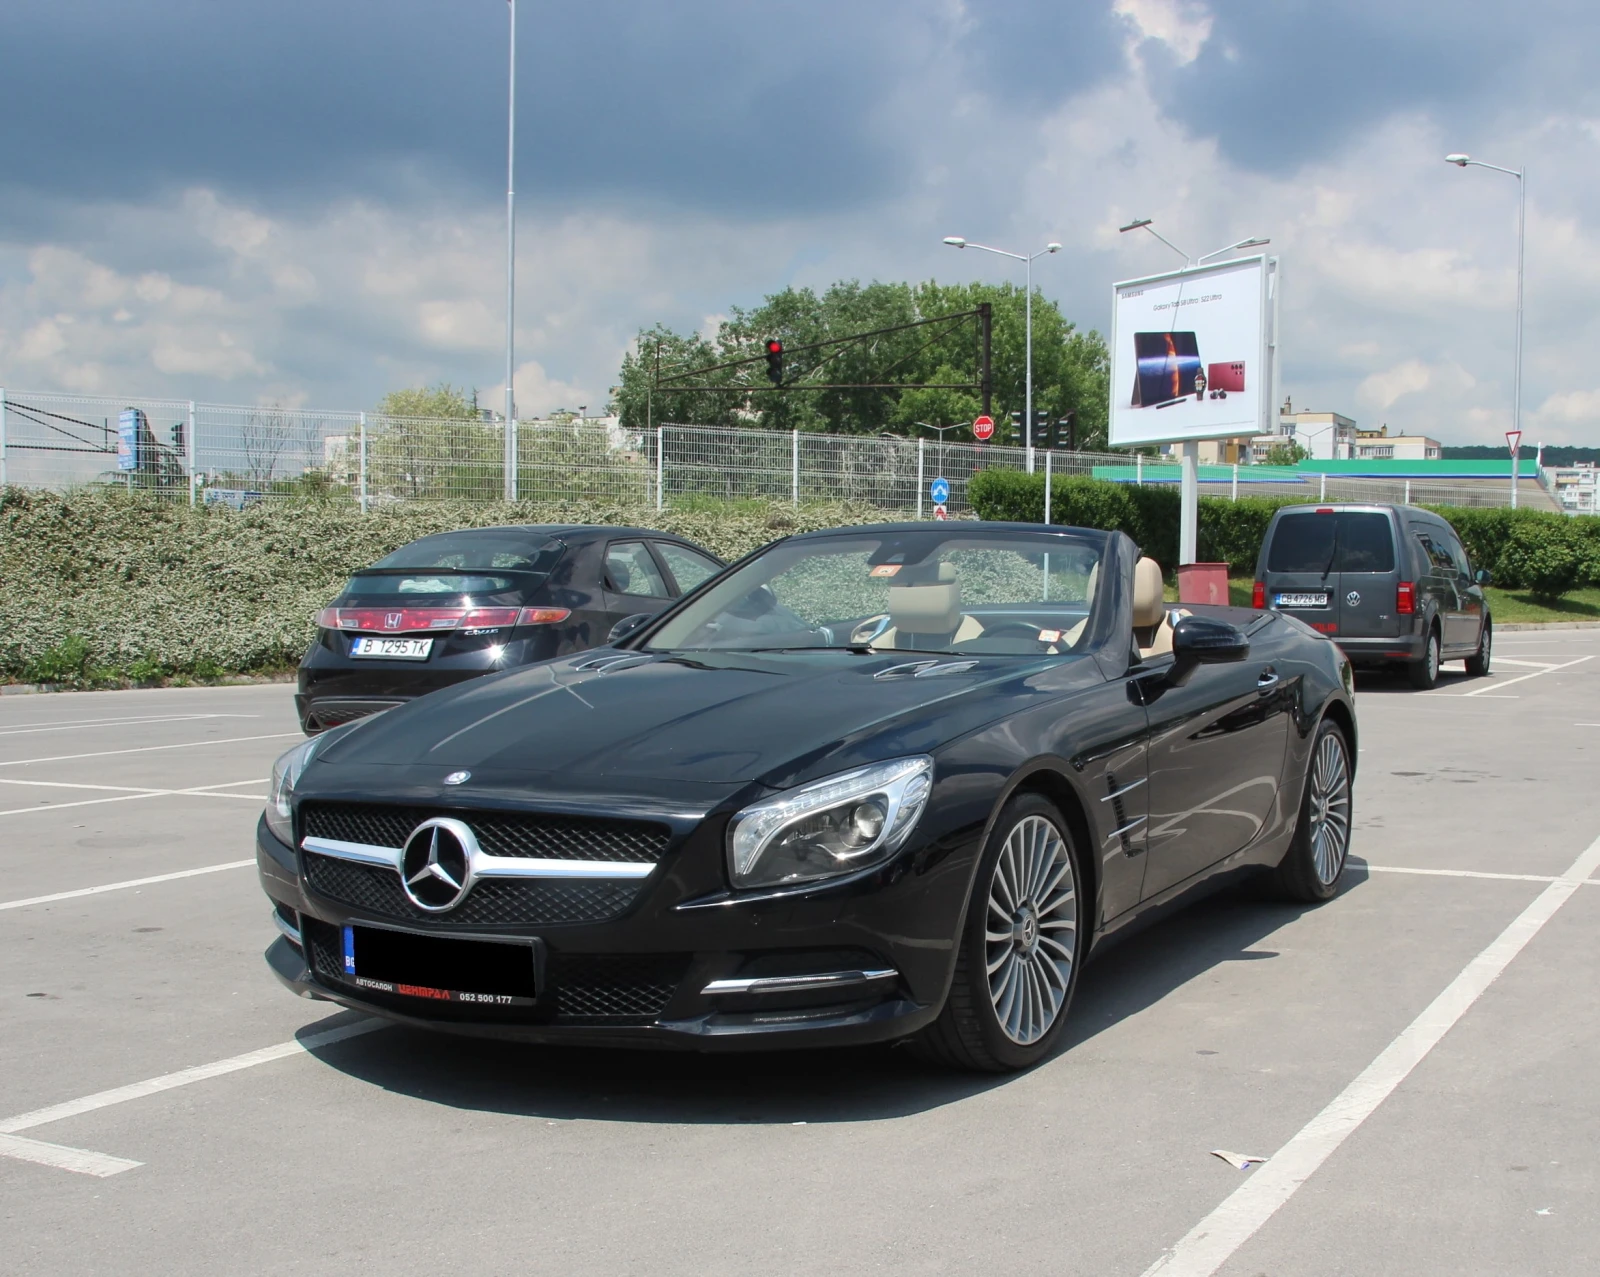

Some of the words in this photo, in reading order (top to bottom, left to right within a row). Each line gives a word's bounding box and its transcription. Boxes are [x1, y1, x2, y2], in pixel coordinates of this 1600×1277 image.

[1153, 302, 1170, 312] Galaxy
[1201, 295, 1210, 303] S22
[975, 423, 992, 433] STOP
[1282, 594, 1292, 604] CB
[1294, 594, 1313, 604] 4726
[363, 639, 373, 653] B
[380, 639, 410, 654] 1295
[411, 640, 429, 655] TK
[355, 977, 393, 992] АВТОСАЛОН
[459, 992, 476, 1002] 052
[477, 993, 494, 1003] 500
[496, 995, 513, 1004] 177
